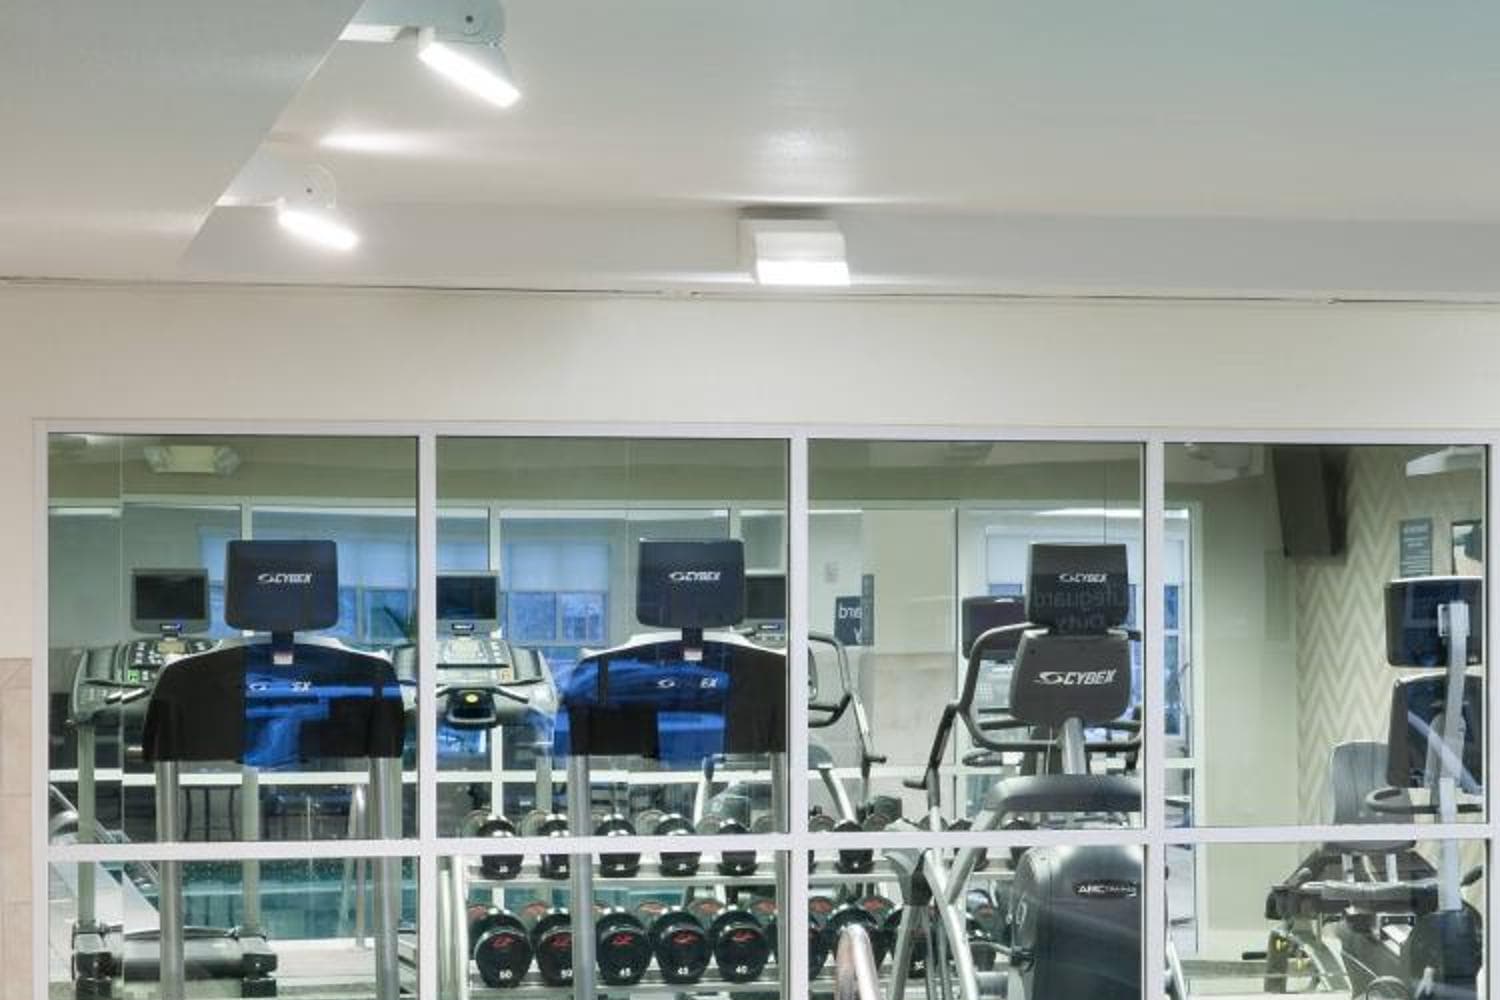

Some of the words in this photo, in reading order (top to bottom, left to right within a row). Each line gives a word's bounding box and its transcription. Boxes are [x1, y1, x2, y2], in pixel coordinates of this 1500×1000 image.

[275, 573, 312, 584] CYBEX
[686, 571, 720, 581] CYBEX
[1074, 573, 1108, 583] CYBEX
[1064, 669, 1117, 685] CYBEX
